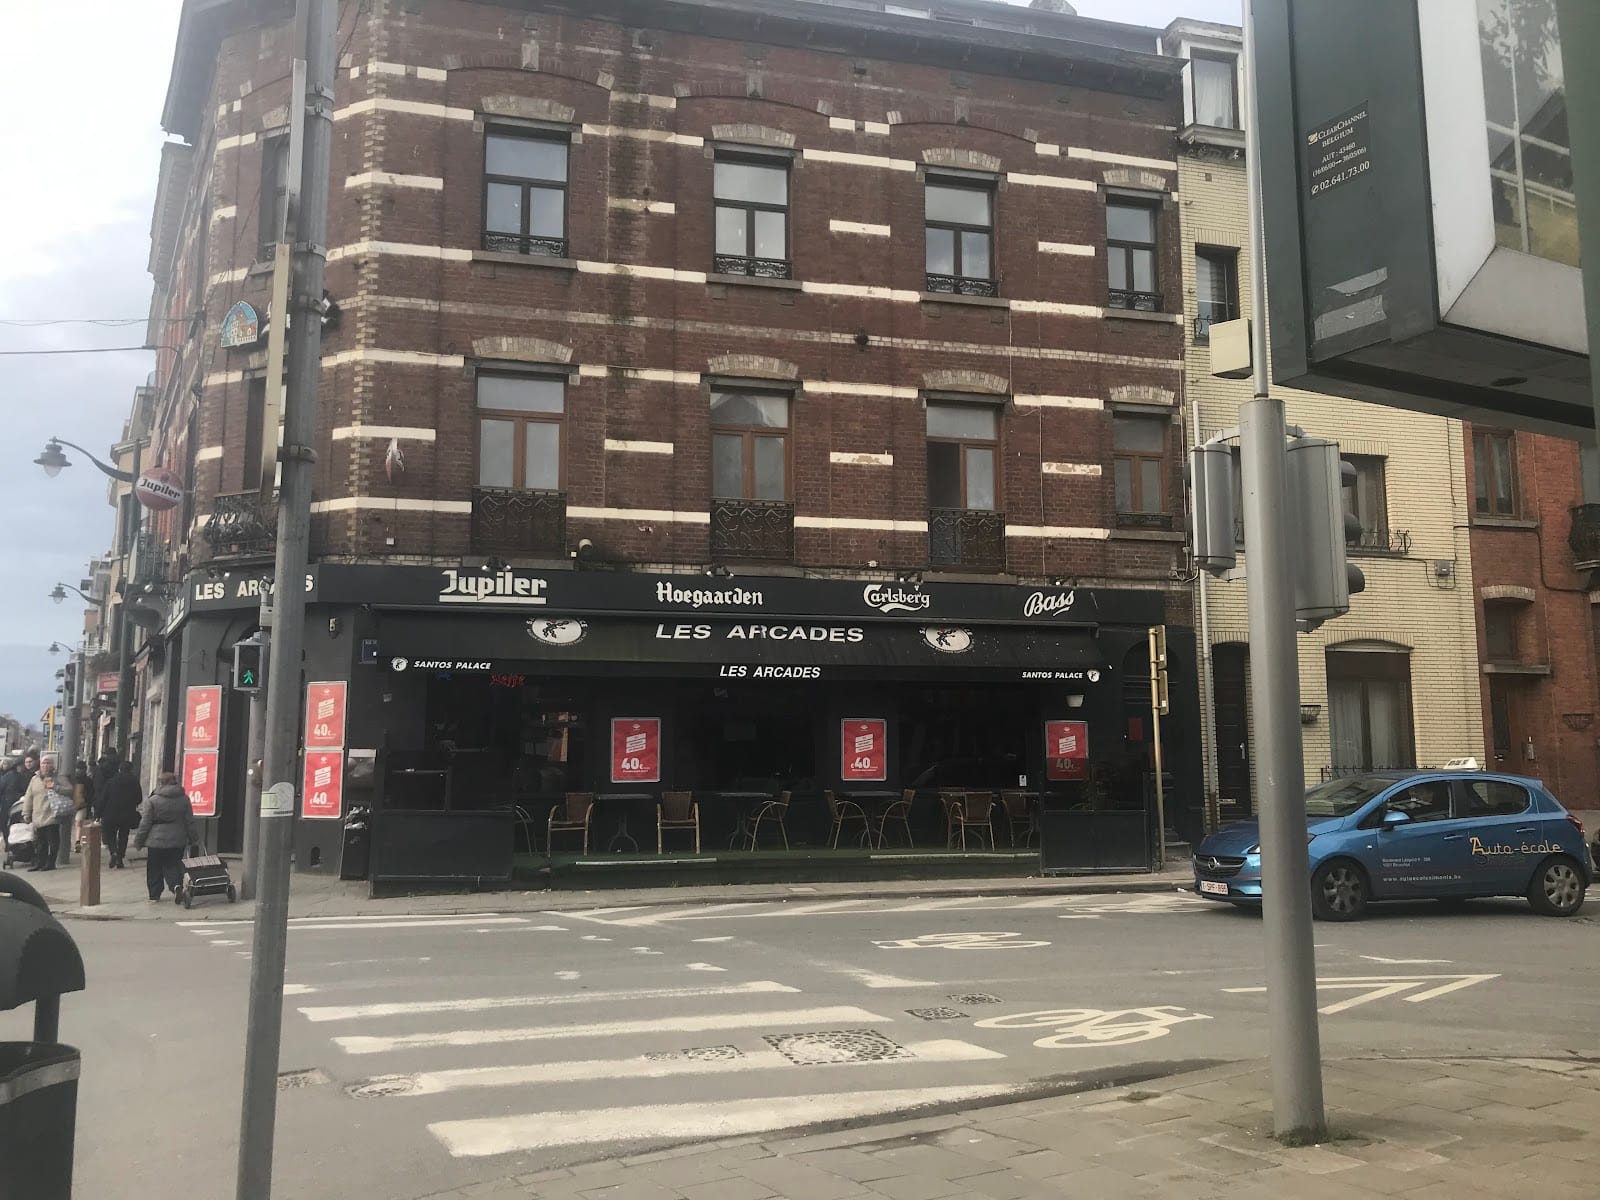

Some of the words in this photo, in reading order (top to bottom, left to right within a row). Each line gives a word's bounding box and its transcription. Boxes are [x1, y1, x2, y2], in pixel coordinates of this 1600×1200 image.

[1322, 127, 1353, 147] BELGIUM
[1320, 160, 1370, 190] 02.641.73.00
[140, 478, 180, 498] Jupiler
[195, 582, 225, 601] LES
[439, 569, 547, 601] Jupiler
[656, 581, 763, 608] Hoegaarden
[863, 584, 930, 610] Carlsberg
[1023, 590, 1074, 617] Bass
[655, 623, 712, 640] LES
[726, 624, 864, 643] ARCADES
[413, 660, 453, 669] SANTOS
[455, 662, 492, 670] PALACE
[719, 665, 748, 678] LES
[752, 666, 821, 679] ARCADES
[1021, 671, 1053, 679] SANTOS
[1469, 836, 1564, 856] Auto-école
